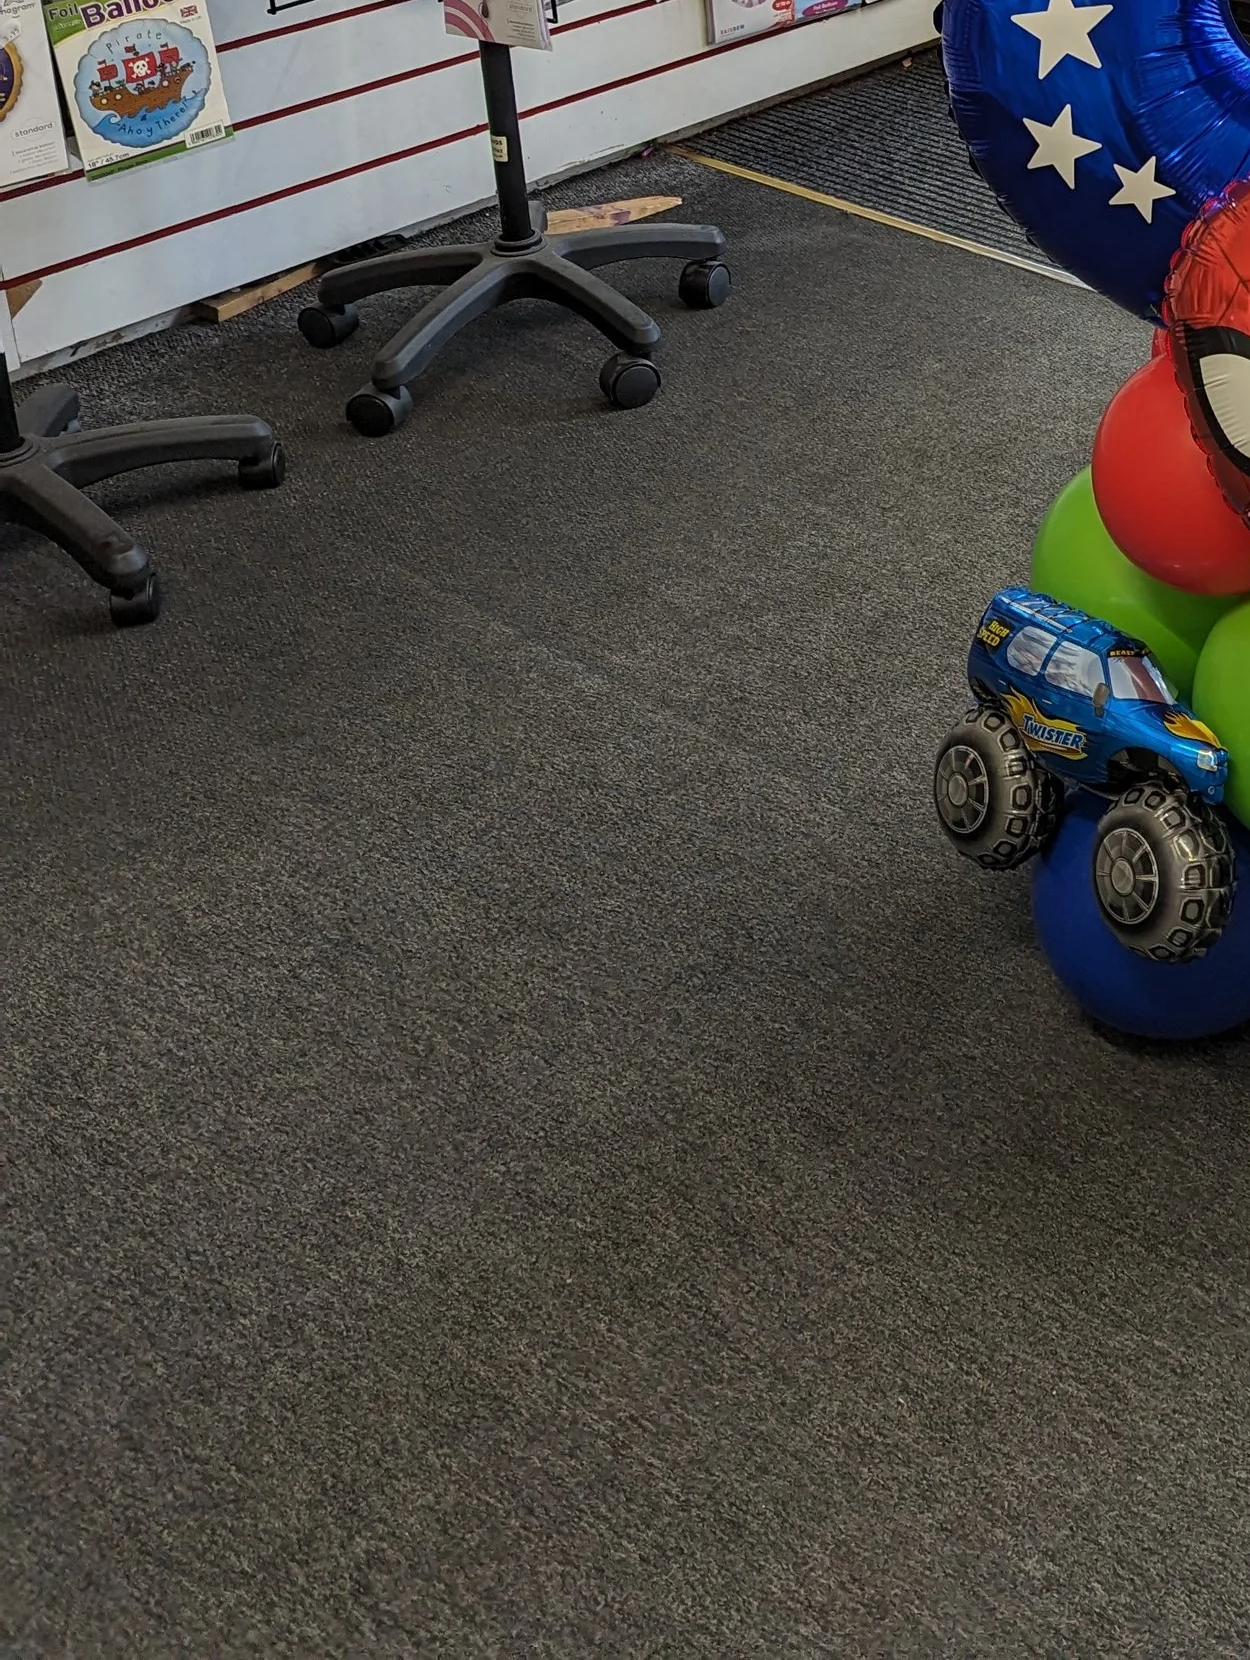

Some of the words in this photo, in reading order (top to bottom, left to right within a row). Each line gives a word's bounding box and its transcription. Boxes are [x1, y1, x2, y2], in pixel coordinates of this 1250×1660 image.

[48, 3, 79, 21] Foil
[106, 30, 163, 55] Pirate
[14, 122, 53, 138] standard
[104, 152, 130, 166] 45.7cm
[977, 628, 1001, 648] SPEED
[988, 620, 1010, 639] HIGH
[1110, 650, 1136, 658] BEAST
[1022, 714, 1085, 750] TWISTER
